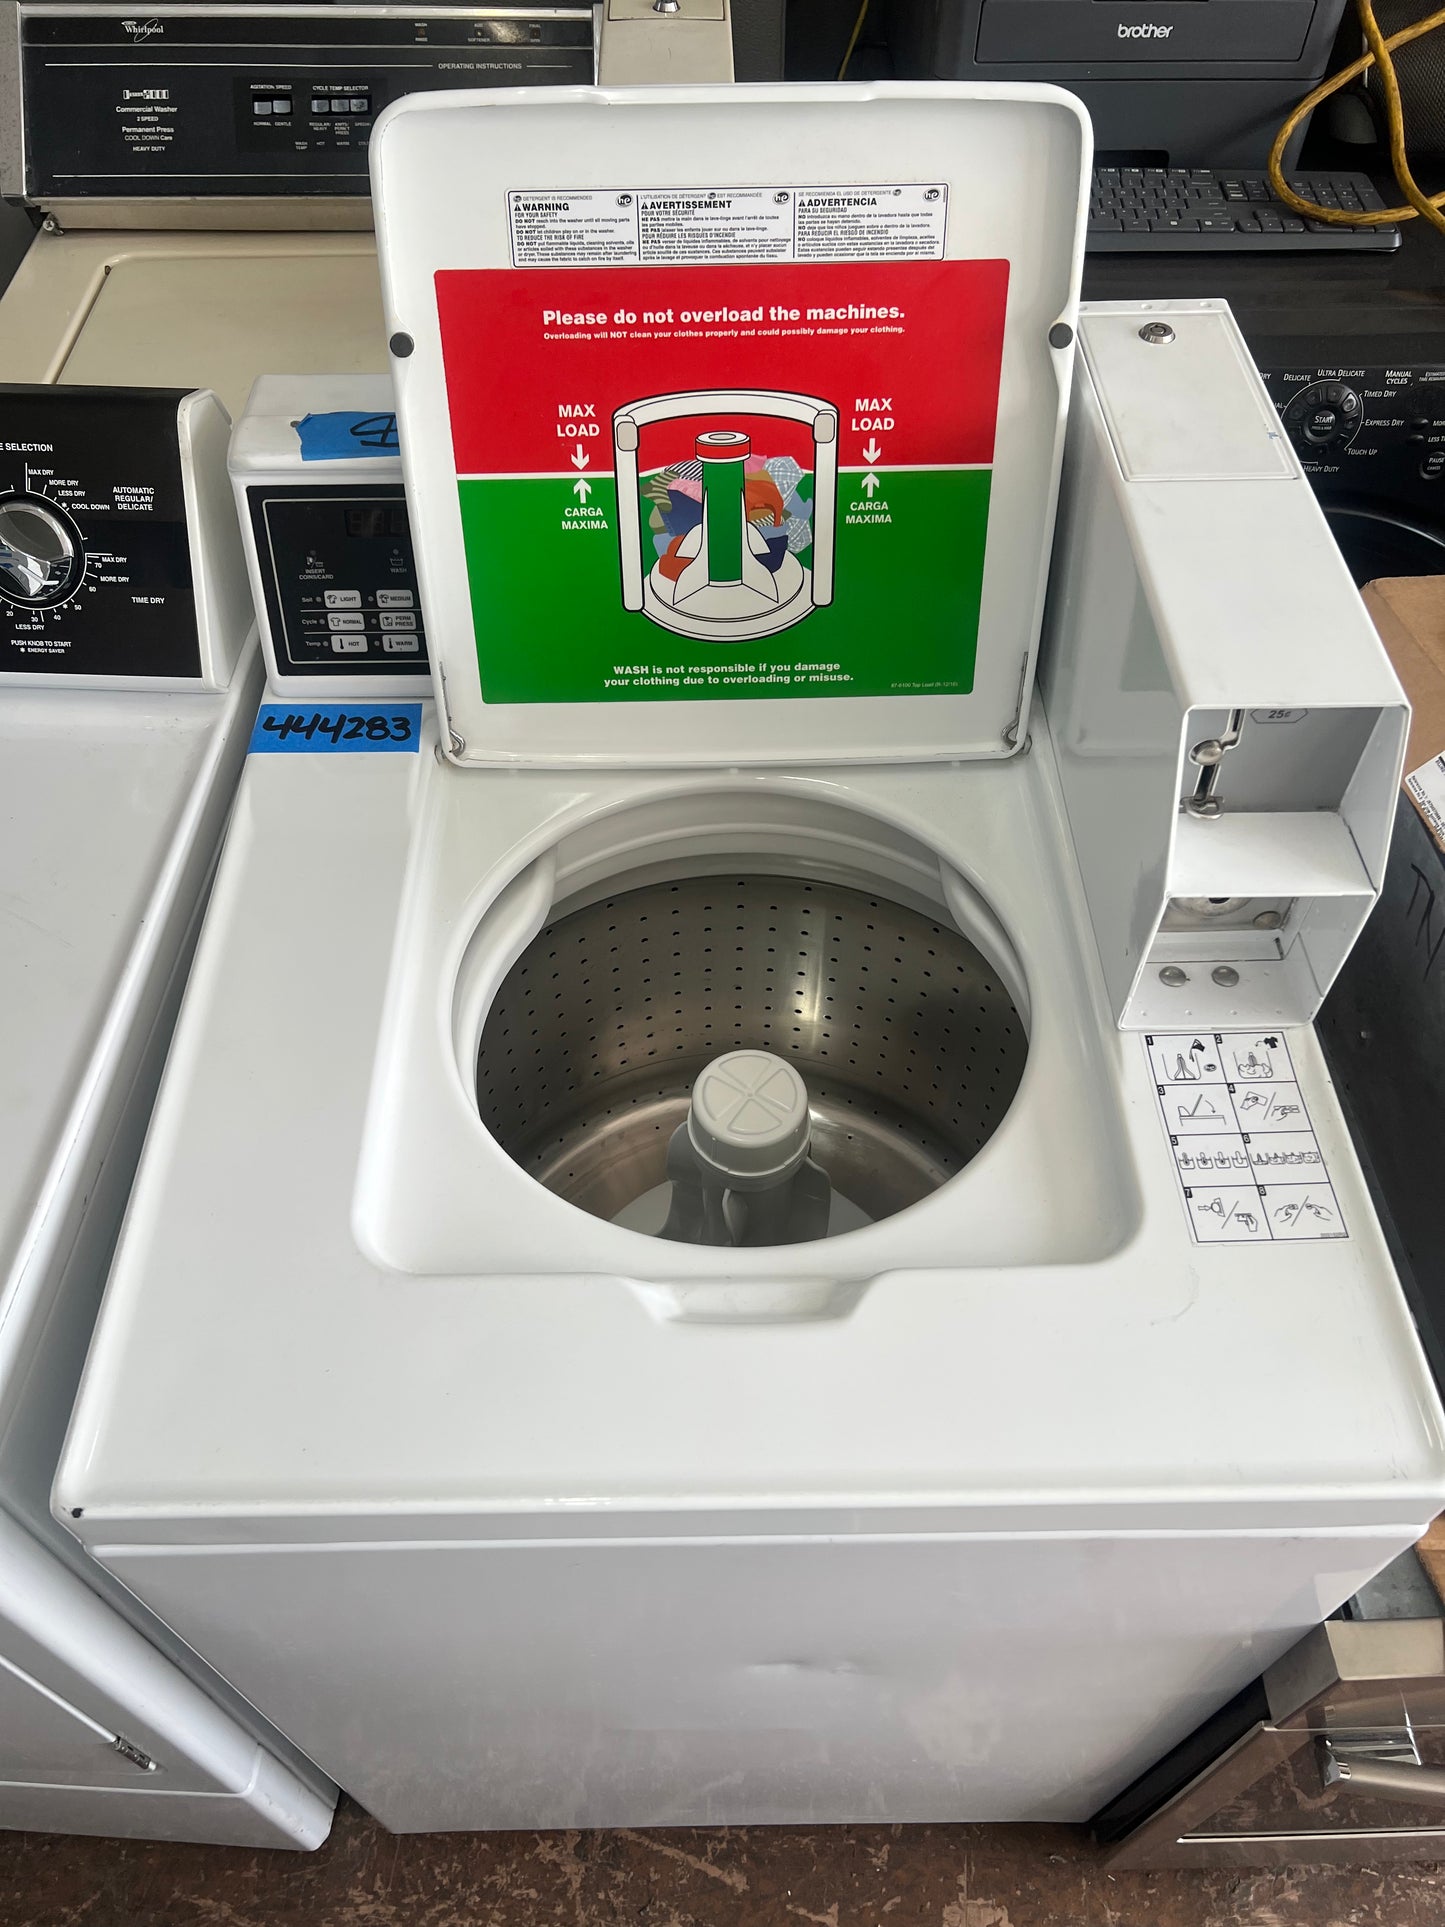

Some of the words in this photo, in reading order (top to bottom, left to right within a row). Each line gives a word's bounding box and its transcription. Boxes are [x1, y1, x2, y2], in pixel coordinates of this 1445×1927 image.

[1117, 23, 1174, 38] brother
[438, 62, 474, 70] OPERATING
[475, 62, 522, 70] INSTRUCTIONS
[525, 202, 570, 211] WARNING
[649, 200, 732, 210] AVERTISSEMENT
[806, 197, 877, 207] ADVERTENCIA
[543, 310, 607, 326] Please
[613, 308, 636, 324] do
[643, 308, 674, 324] not
[679, 306, 764, 323] overload
[768, 305, 801, 321] the
[806, 304, 905, 321] machines.
[543, 332, 591, 341] Overloading
[593, 331, 608, 339] will
[653, 331, 672, 339] your
[705, 329, 738, 338] properly
[757, 328, 780, 336] could
[781, 327, 814, 336] possibly
[816, 327, 848, 335] damage
[850, 327, 868, 335] your
[869, 326, 905, 334] clothing.
[1283, 373, 1311, 381] DELICATE
[1317, 369, 1336, 377] ULTRA
[1337, 369, 1365, 378] DELICATE
[1384, 370, 1412, 378] MANUAL
[1364, 390, 1383, 398] TIMED
[1383, 390, 1398, 398] DRY
[855, 397, 892, 412] MAX
[558, 404, 596, 418] MAX
[851, 417, 895, 431] LOAD
[1391, 419, 1405, 427] DRY
[556, 423, 600, 437] LOAD
[4, 442, 53, 452] SELECTION
[1347, 448, 1368, 456] TOUCH
[1323, 465, 1340, 473] DUTY
[112, 486, 155, 494] AUTOMATIC
[114, 494, 154, 503] REGULAR/
[117, 503, 153, 511] DELICATE
[850, 501, 888, 511] CARGA
[564, 507, 603, 517] CARGA
[845, 514, 892, 524] MAXIMA
[561, 520, 608, 530] MAXIMA
[131, 596, 149, 604] TIME
[613, 665, 649, 675] WASH
[652, 665, 662, 674] is
[665, 665, 684, 674] not
[688, 663, 755, 676] responsible
[758, 662, 766, 672] if
[769, 664, 790, 674] you
[794, 662, 840, 673] damage
[603, 678, 630, 688] your
[632, 676, 679, 687] clothing
[682, 676, 704, 685] due
[707, 675, 719, 684] to
[722, 673, 790, 685] overloading
[808, 673, 853, 682] misuse.
[262, 713, 412, 744] 444283
[1147, 1037, 1152, 1045] 1
[1216, 1035, 1221, 1043] 2
[1185, 1189, 1191, 1197] 7
